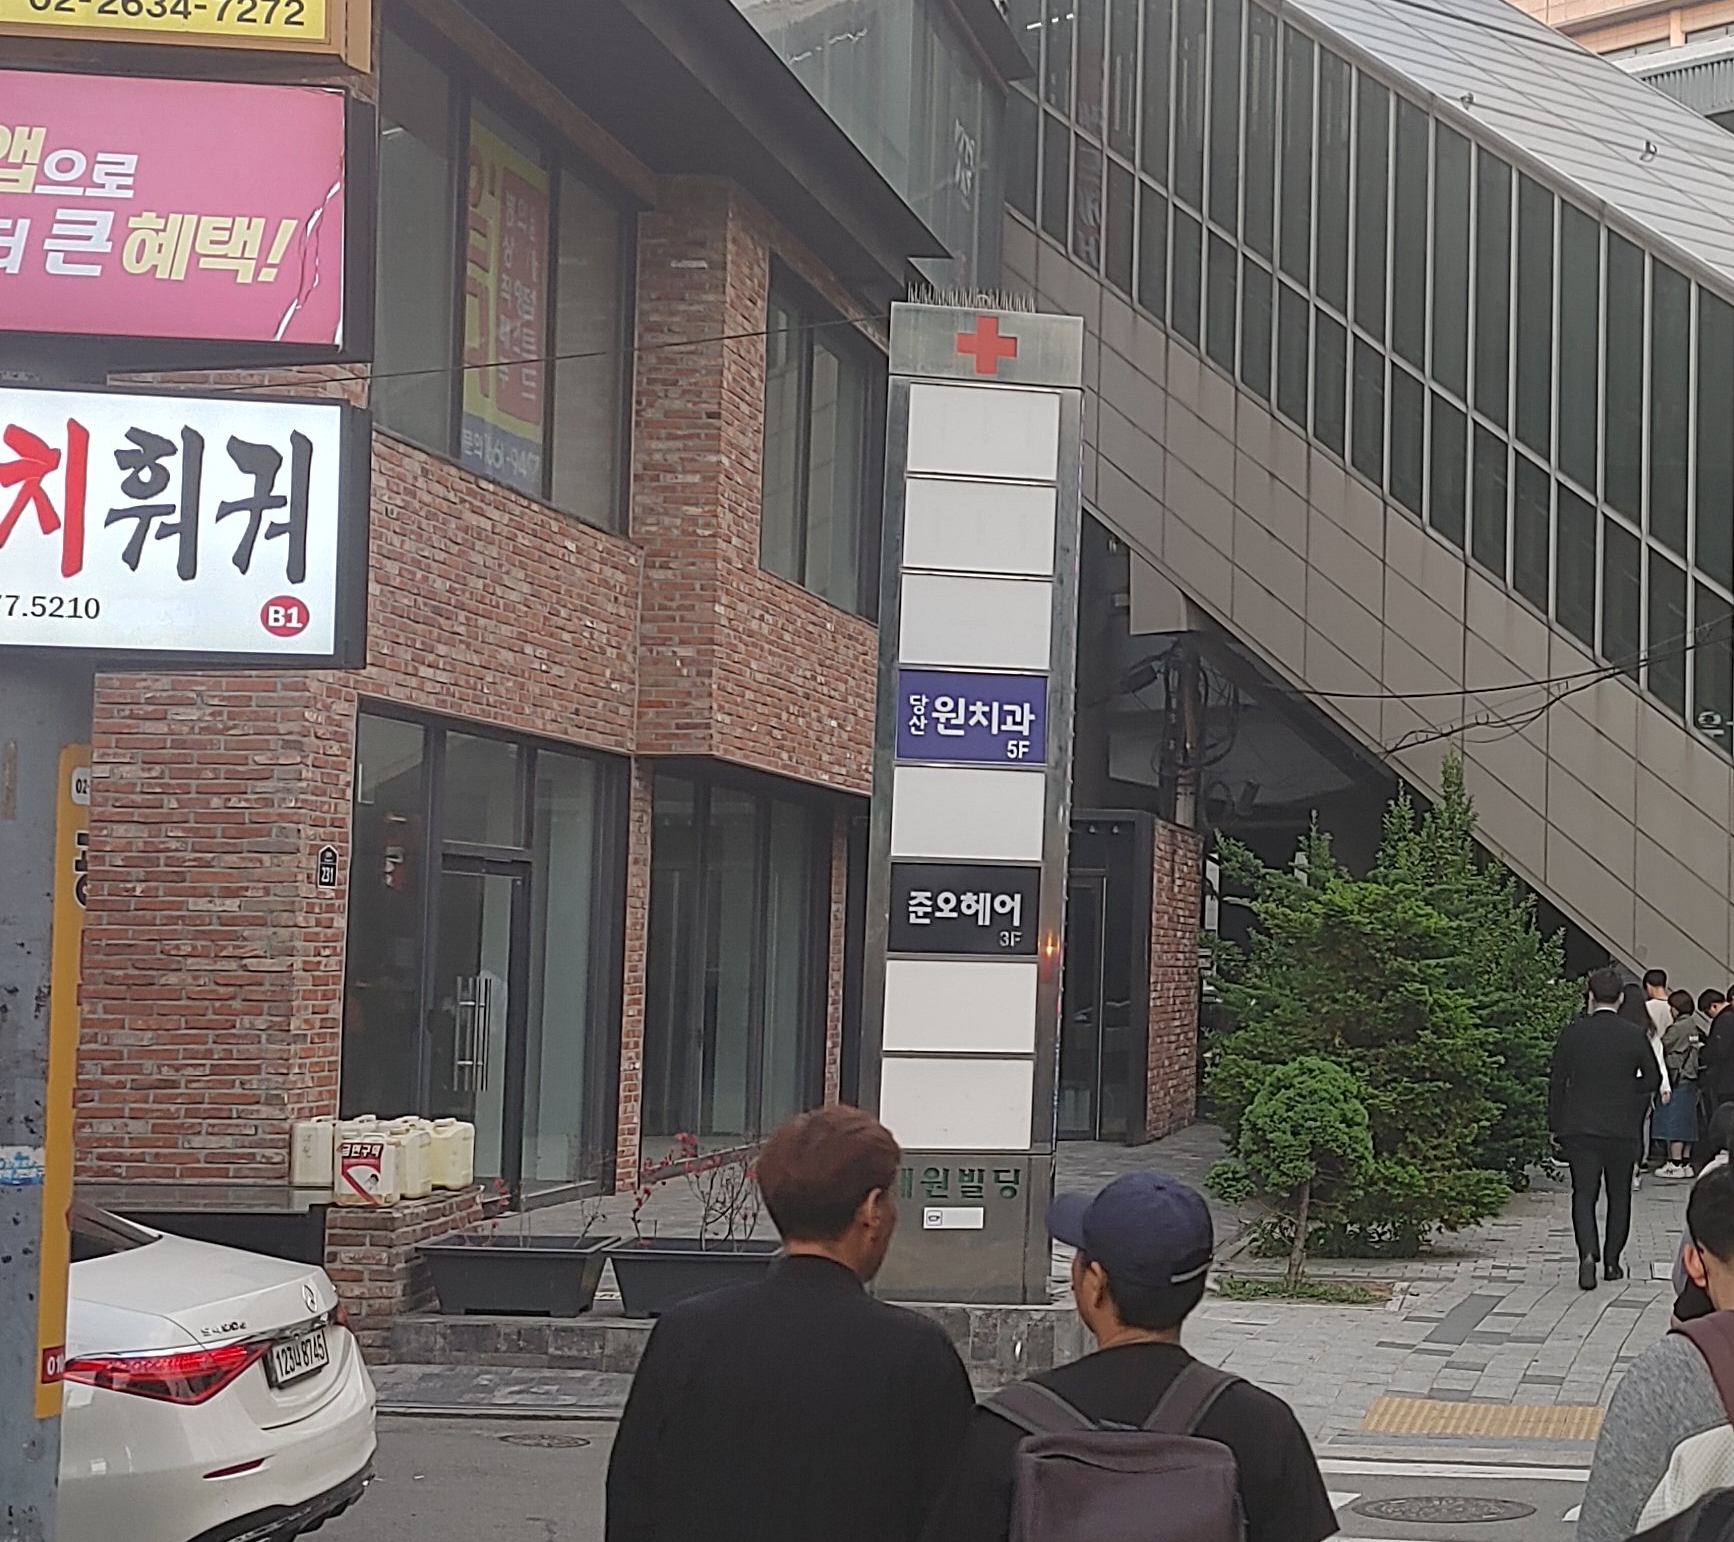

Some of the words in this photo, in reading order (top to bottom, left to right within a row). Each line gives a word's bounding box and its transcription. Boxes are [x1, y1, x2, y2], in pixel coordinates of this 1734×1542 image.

[43, 208, 115, 276] 큰
[122, 211, 298, 283] 혜택!
[0, 594, 100, 619] 7.5210
[266, 606, 303, 628] B1
[908, 694, 930, 736] 당산
[931, 695, 1036, 737] 원치과
[1006, 740, 1031, 759] 5F
[321, 866, 334, 884] 231
[908, 891, 1022, 927] 준오헤어
[999, 931, 1022, 947] 3F
